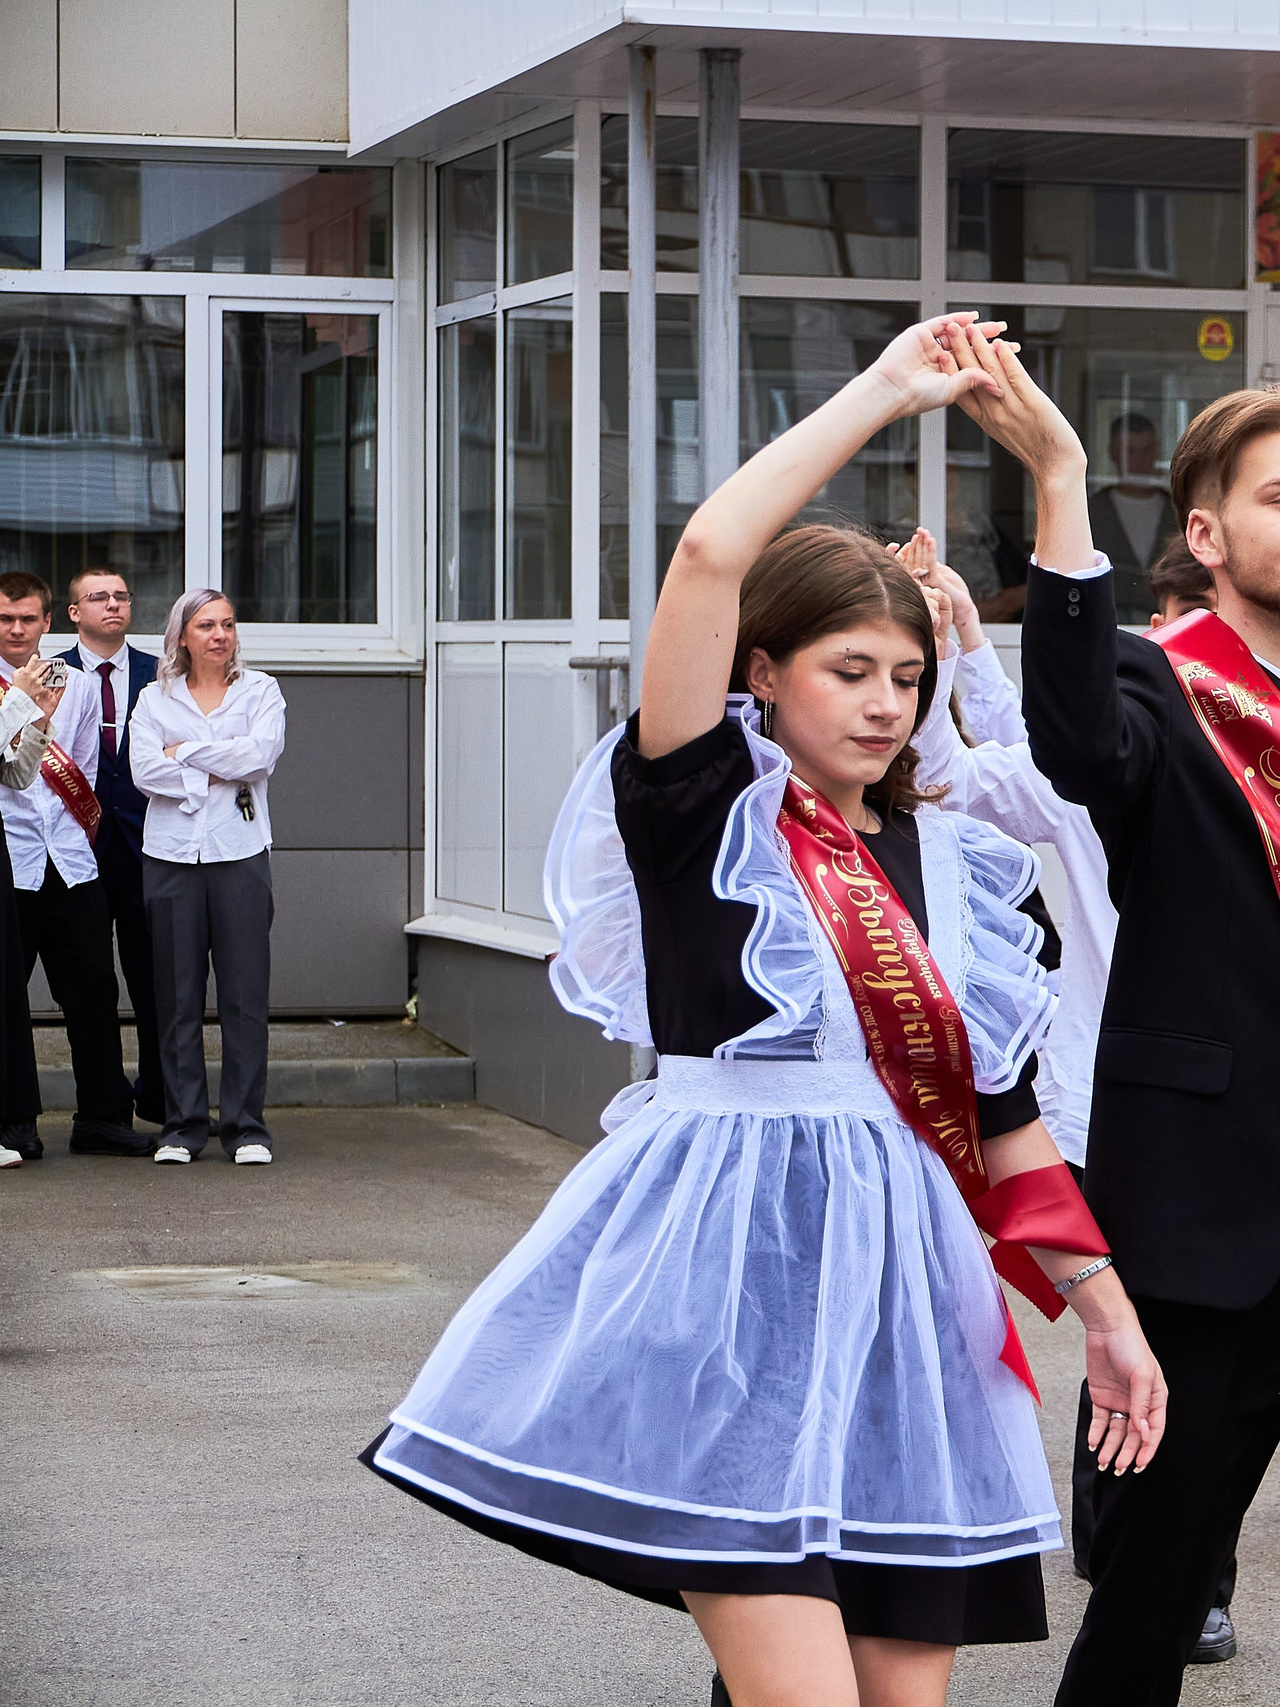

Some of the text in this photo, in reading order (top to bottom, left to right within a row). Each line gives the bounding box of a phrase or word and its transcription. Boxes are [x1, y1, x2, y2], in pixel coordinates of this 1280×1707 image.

[831, 848, 941, 1109] Выпускница
[897, 918, 943, 999] Трудецкая
[860, 1005, 878, 1027] СОШ
